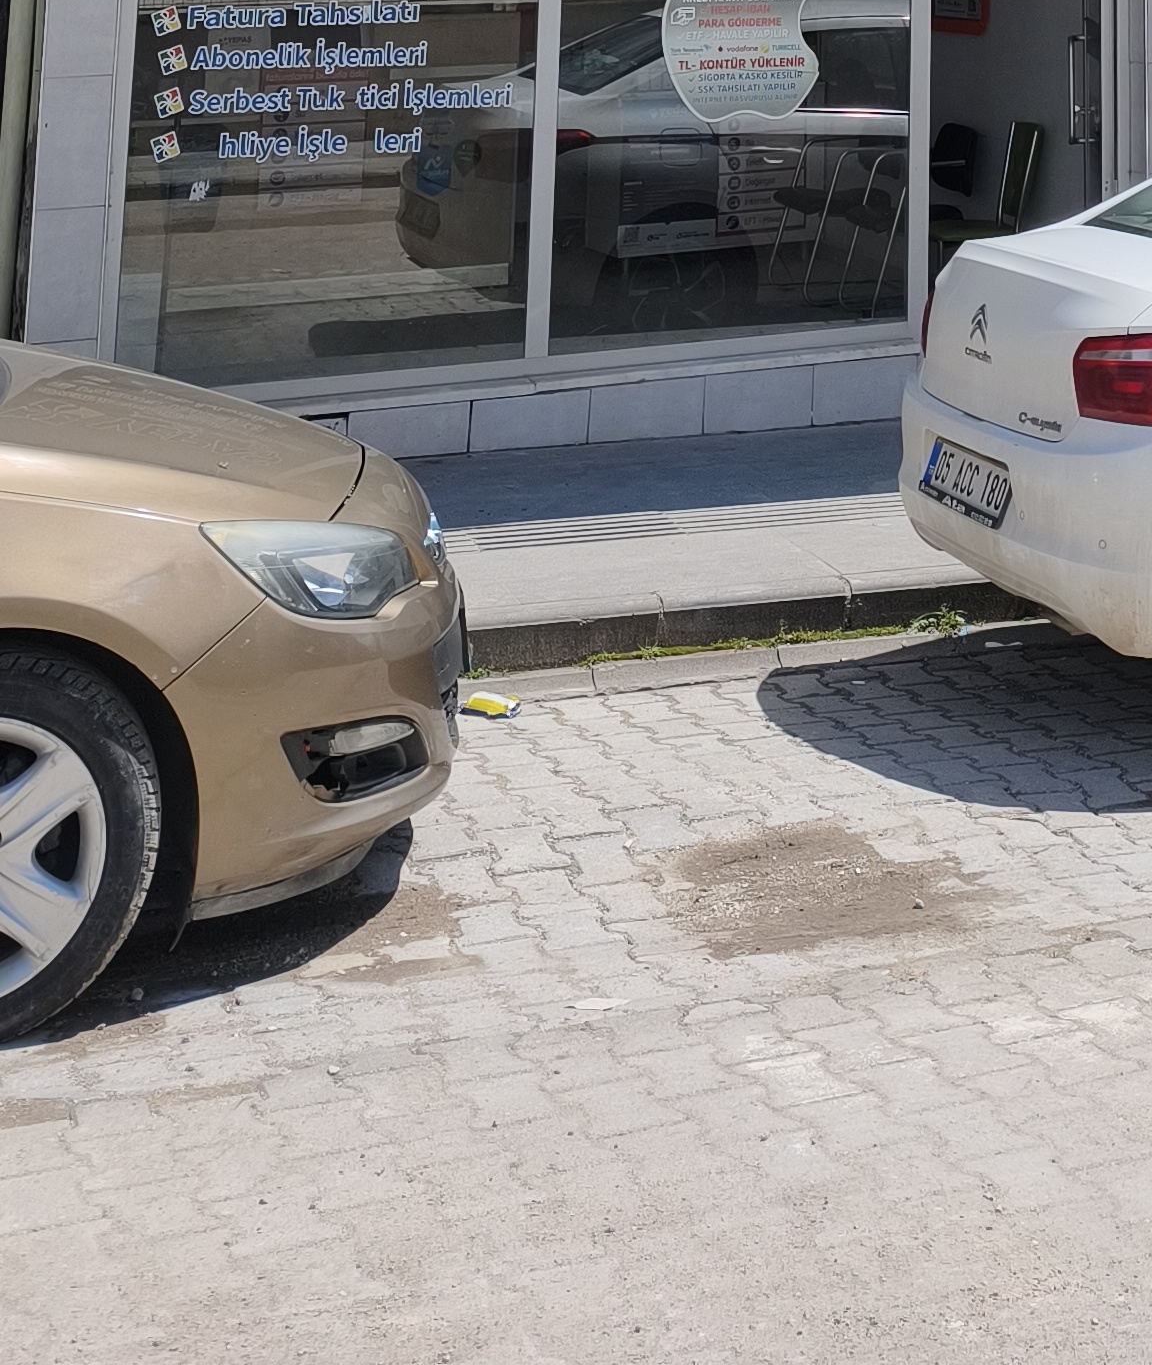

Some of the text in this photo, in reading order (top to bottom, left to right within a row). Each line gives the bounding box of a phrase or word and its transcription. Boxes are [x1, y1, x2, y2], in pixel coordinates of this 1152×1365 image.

[187, 4, 286, 29] Fatura
[698, 17, 782, 28] PARA GÖNDERME
[228, 36, 252, 44] YEPAŞ
[713, 29, 749, 40] HAVALE
[753, 28, 789, 39] YAPILIR
[727, 45, 758, 53] vodafone
[190, 38, 428, 74] Abonelik İşlemleri
[700, 57, 746, 70] KONTÜR
[750, 54, 805, 68] YÜKLENİR
[739, 72, 768, 81] KASKO
[698, 85, 714, 94] SSK
[188, 87, 292, 114] Serbest
[403, 79, 513, 115] İşlemleri
[934, 450, 1008, 511] 05 ACC 180
